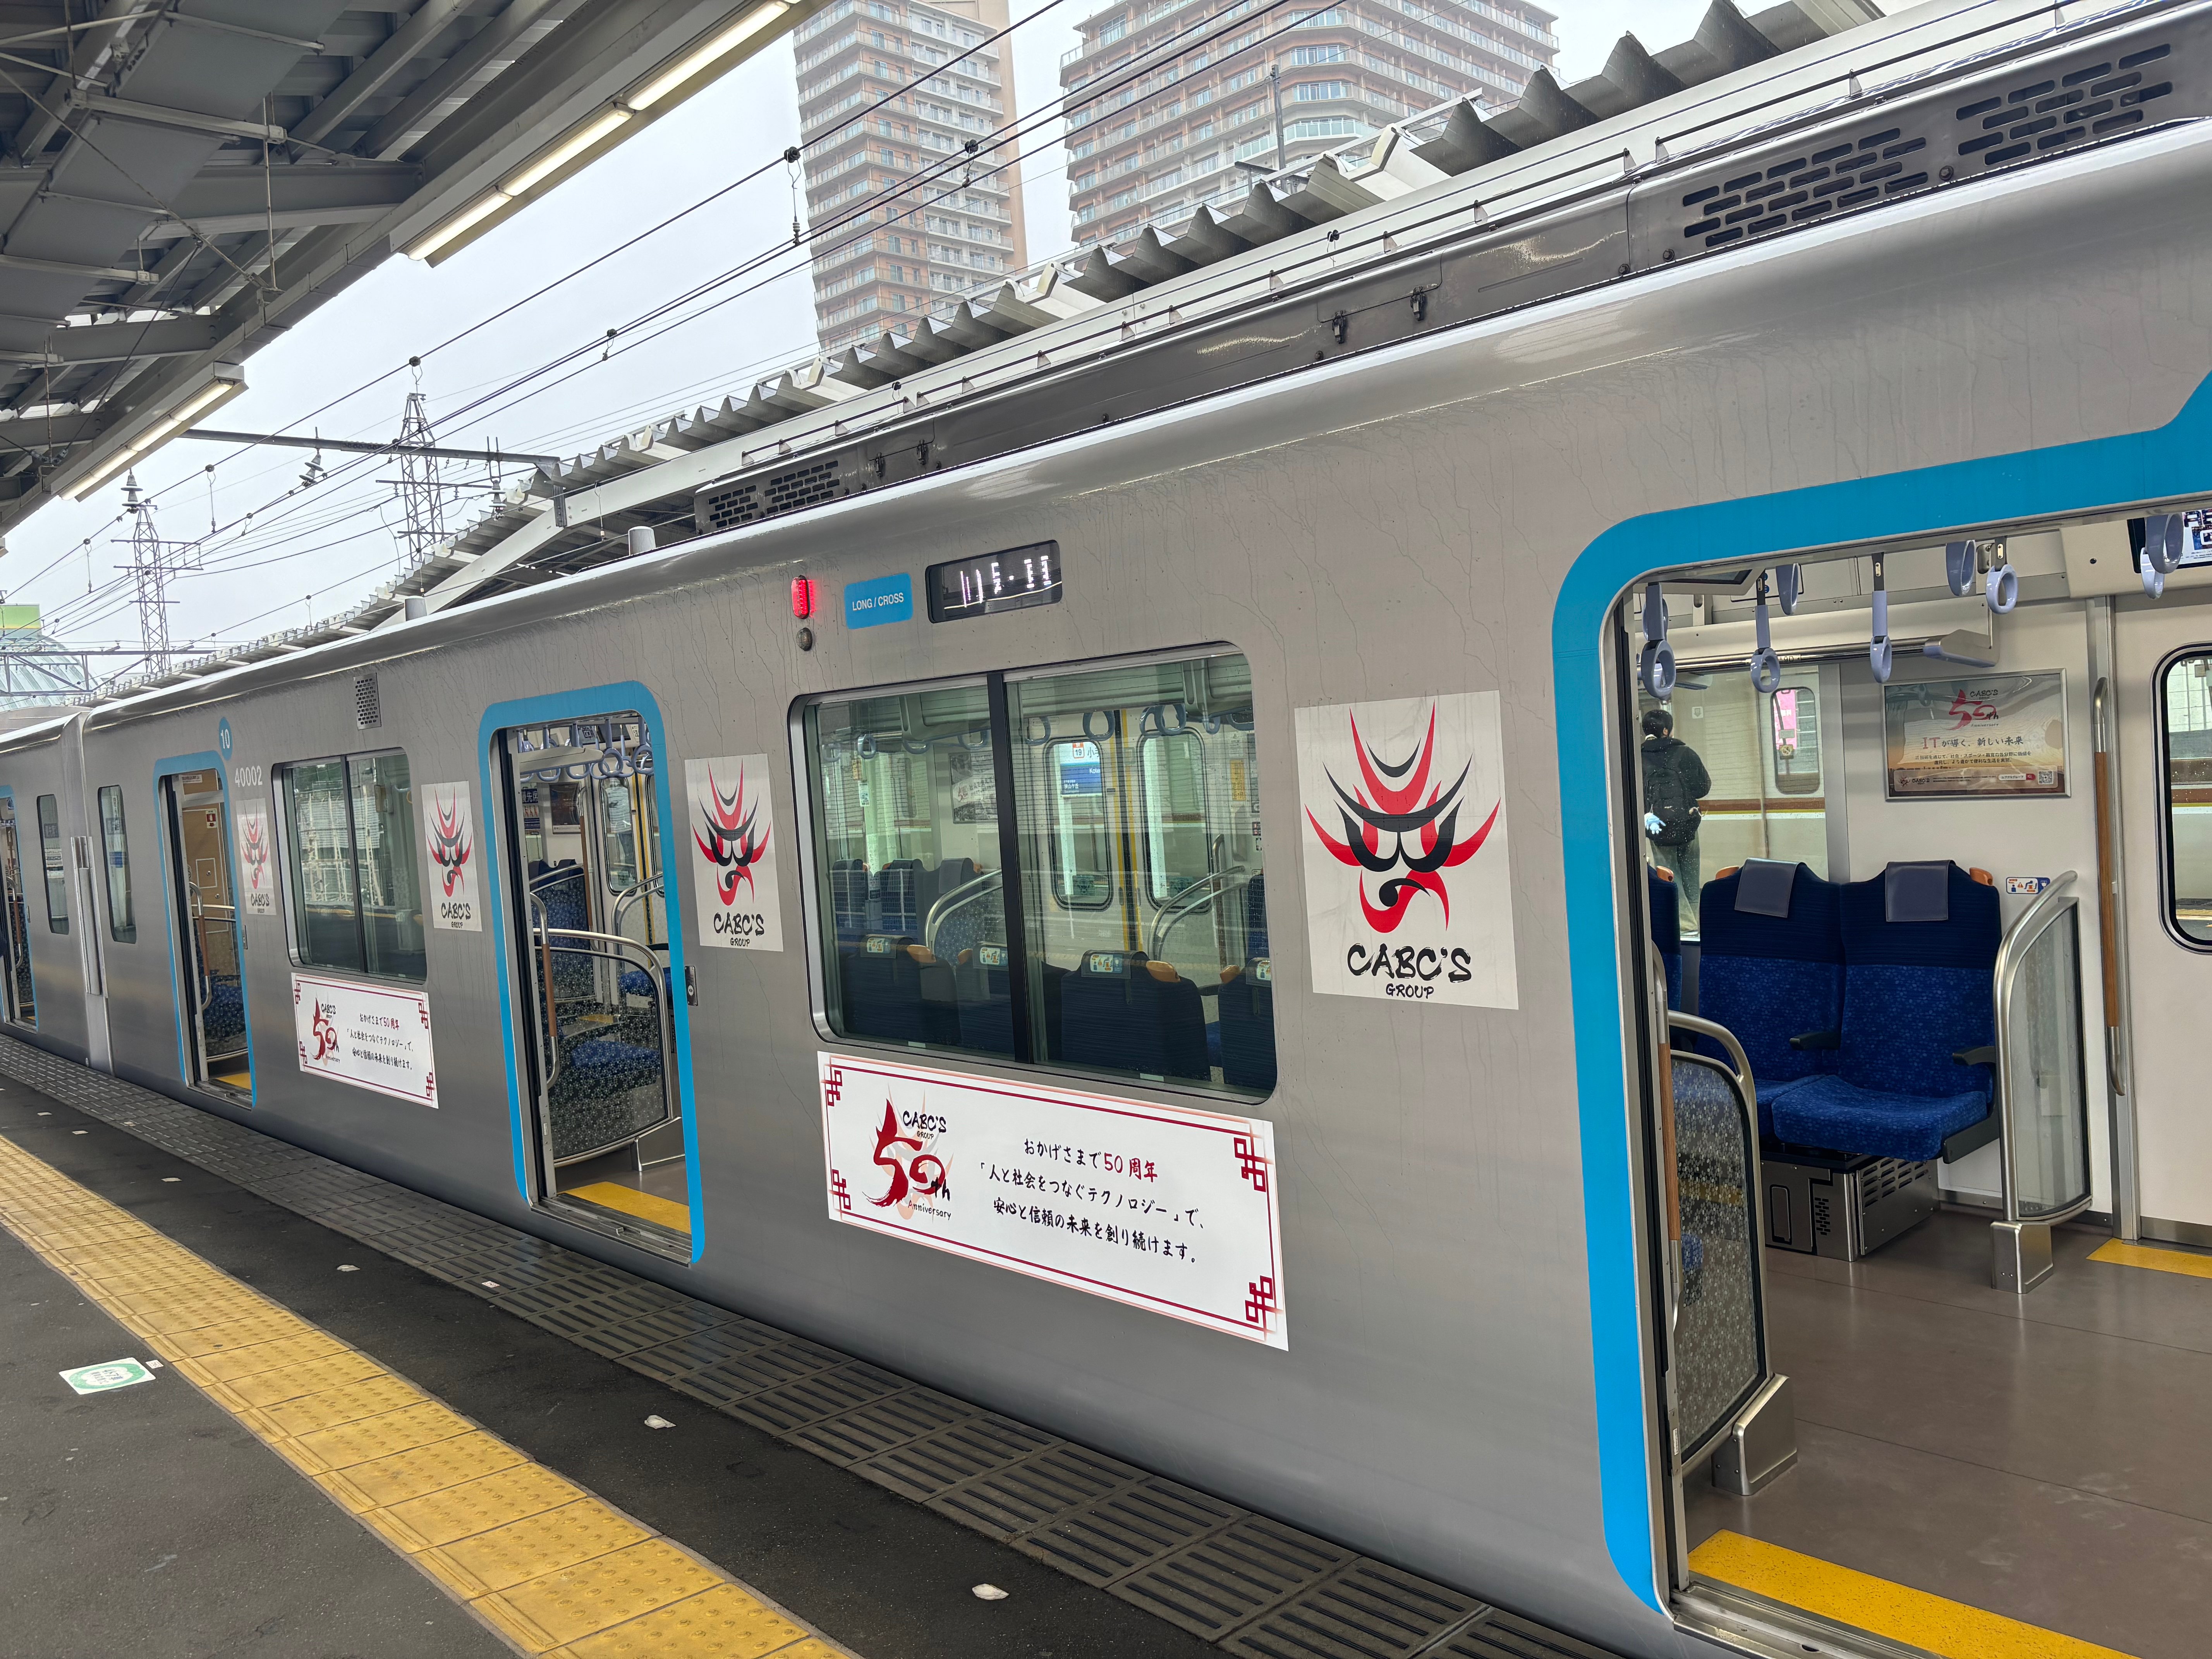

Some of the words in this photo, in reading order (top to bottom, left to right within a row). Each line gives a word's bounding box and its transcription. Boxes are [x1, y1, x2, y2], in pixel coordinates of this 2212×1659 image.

[853, 598, 872, 611] LONG
[878, 593, 904, 606] CROSS
[220, 729, 230, 749] 10
[235, 765, 263, 787] 40002
[441, 902, 471, 920] CABC'S
[714, 912, 764, 936] CABC'S
[730, 938, 750, 947] GROUP
[1347, 943, 1472, 983] CABC'S
[1386, 983, 1434, 999] GROUP
[321, 1003, 336, 1015] CABC'S
[903, 1110, 946, 1133] CABC'S
[917, 1130, 934, 1140] GROUP
[908, 1199, 951, 1220] Anniversary
